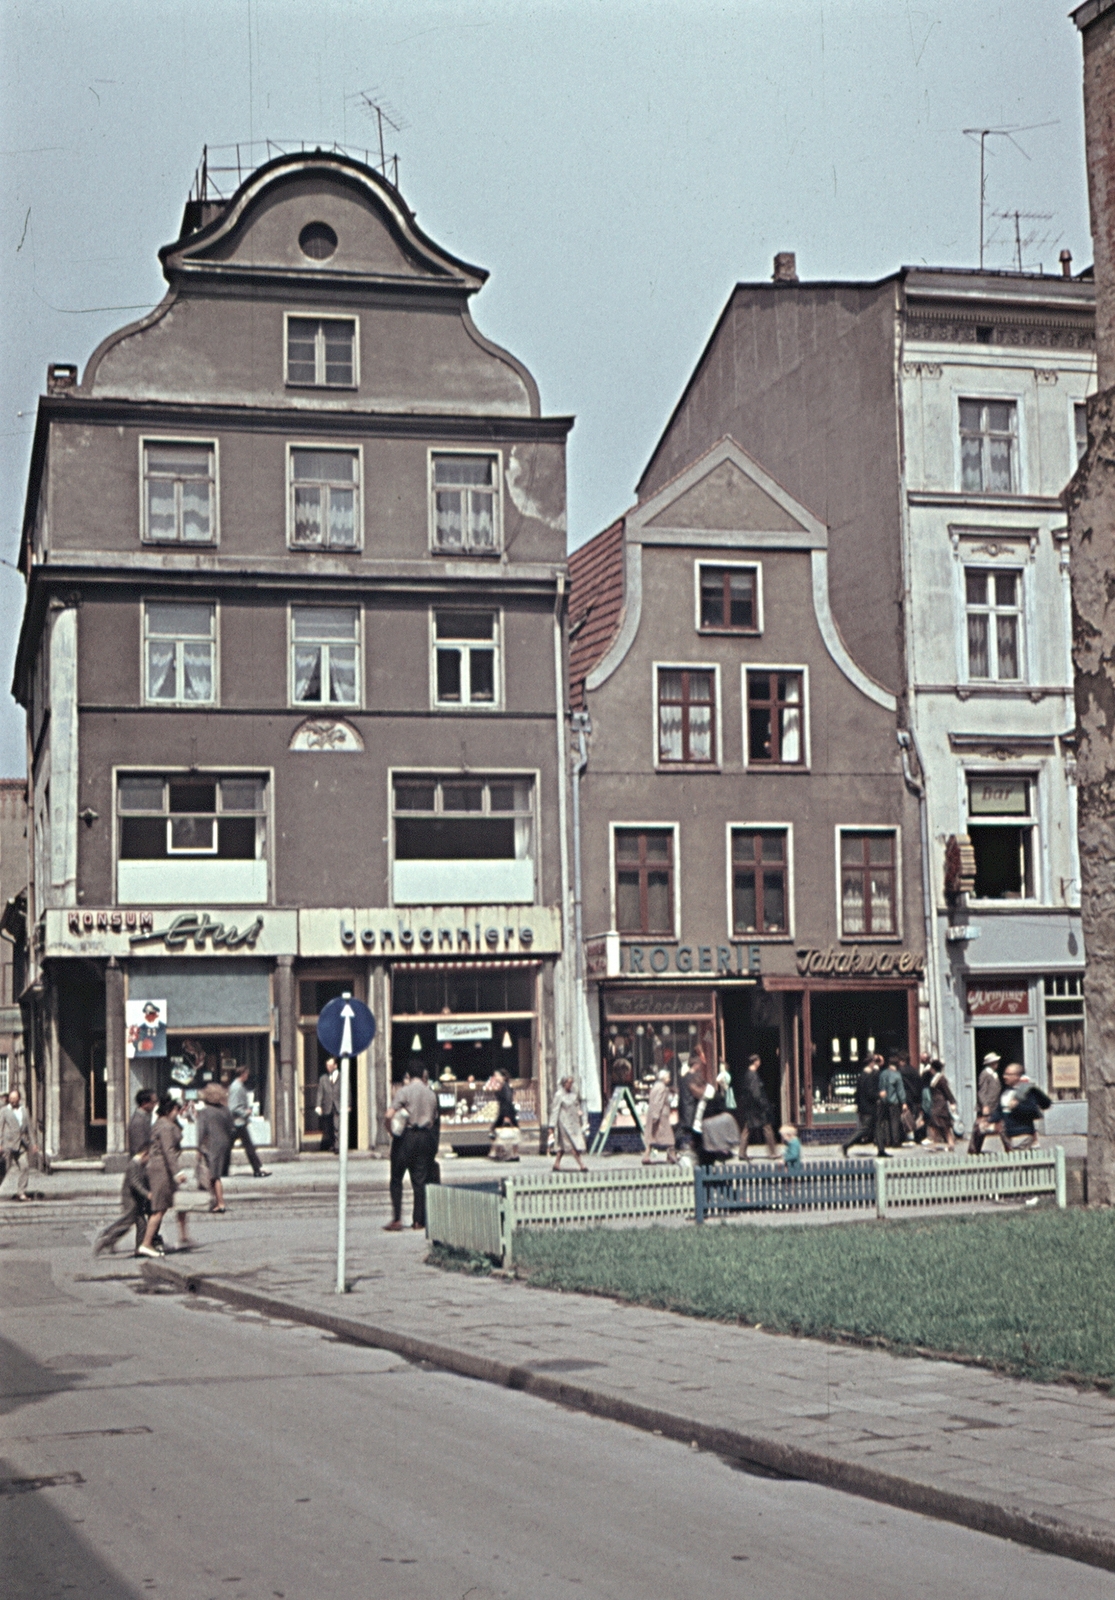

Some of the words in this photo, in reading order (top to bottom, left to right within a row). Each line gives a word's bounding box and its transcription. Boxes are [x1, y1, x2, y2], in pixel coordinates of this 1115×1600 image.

[69, 912, 153, 928] KONSUM
[129, 913, 264, 948] Etui
[340, 919, 533, 948] bonbonniere
[796, 944, 926, 975] Tabakwaren
